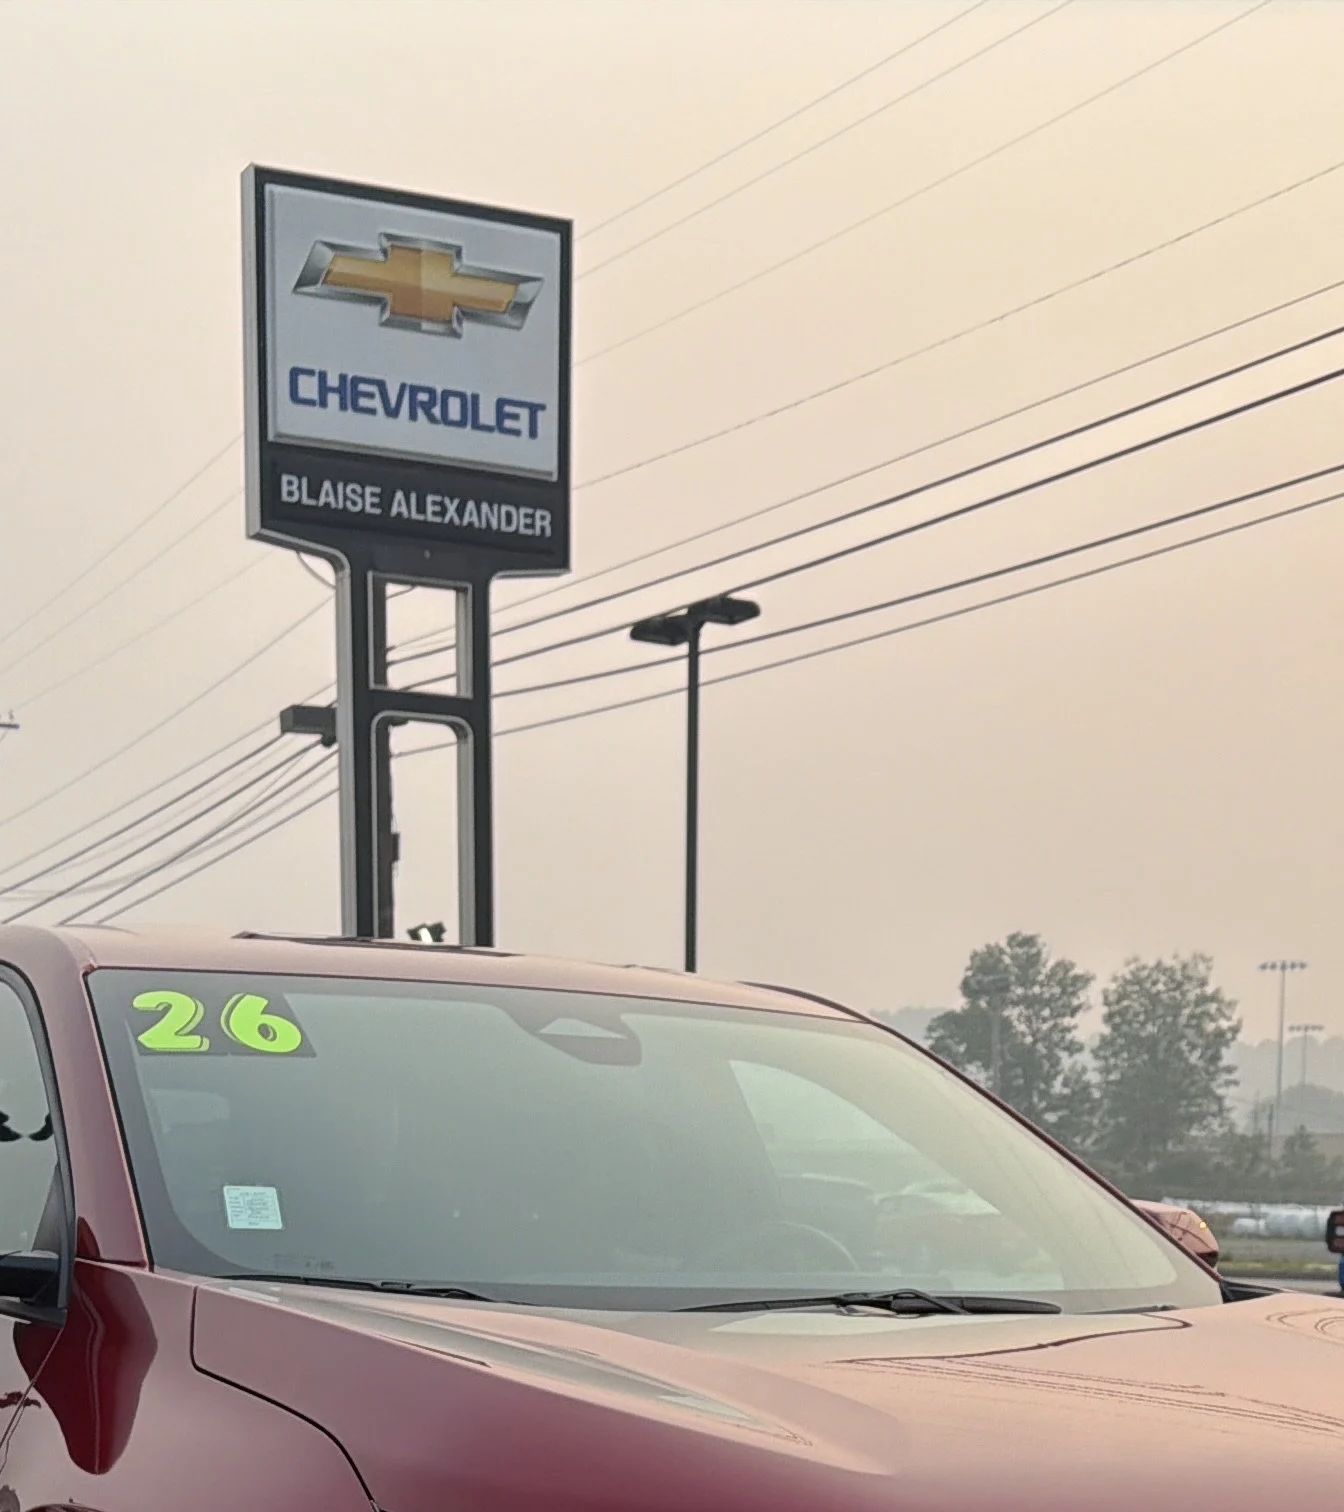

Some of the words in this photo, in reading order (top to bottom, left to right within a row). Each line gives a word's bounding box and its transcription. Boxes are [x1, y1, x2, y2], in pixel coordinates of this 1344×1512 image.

[289, 367, 547, 439] CHEVROLET
[280, 473, 382, 515] BLAISE
[390, 489, 552, 538] ALEXANDER
[132, 990, 303, 1054] 26
